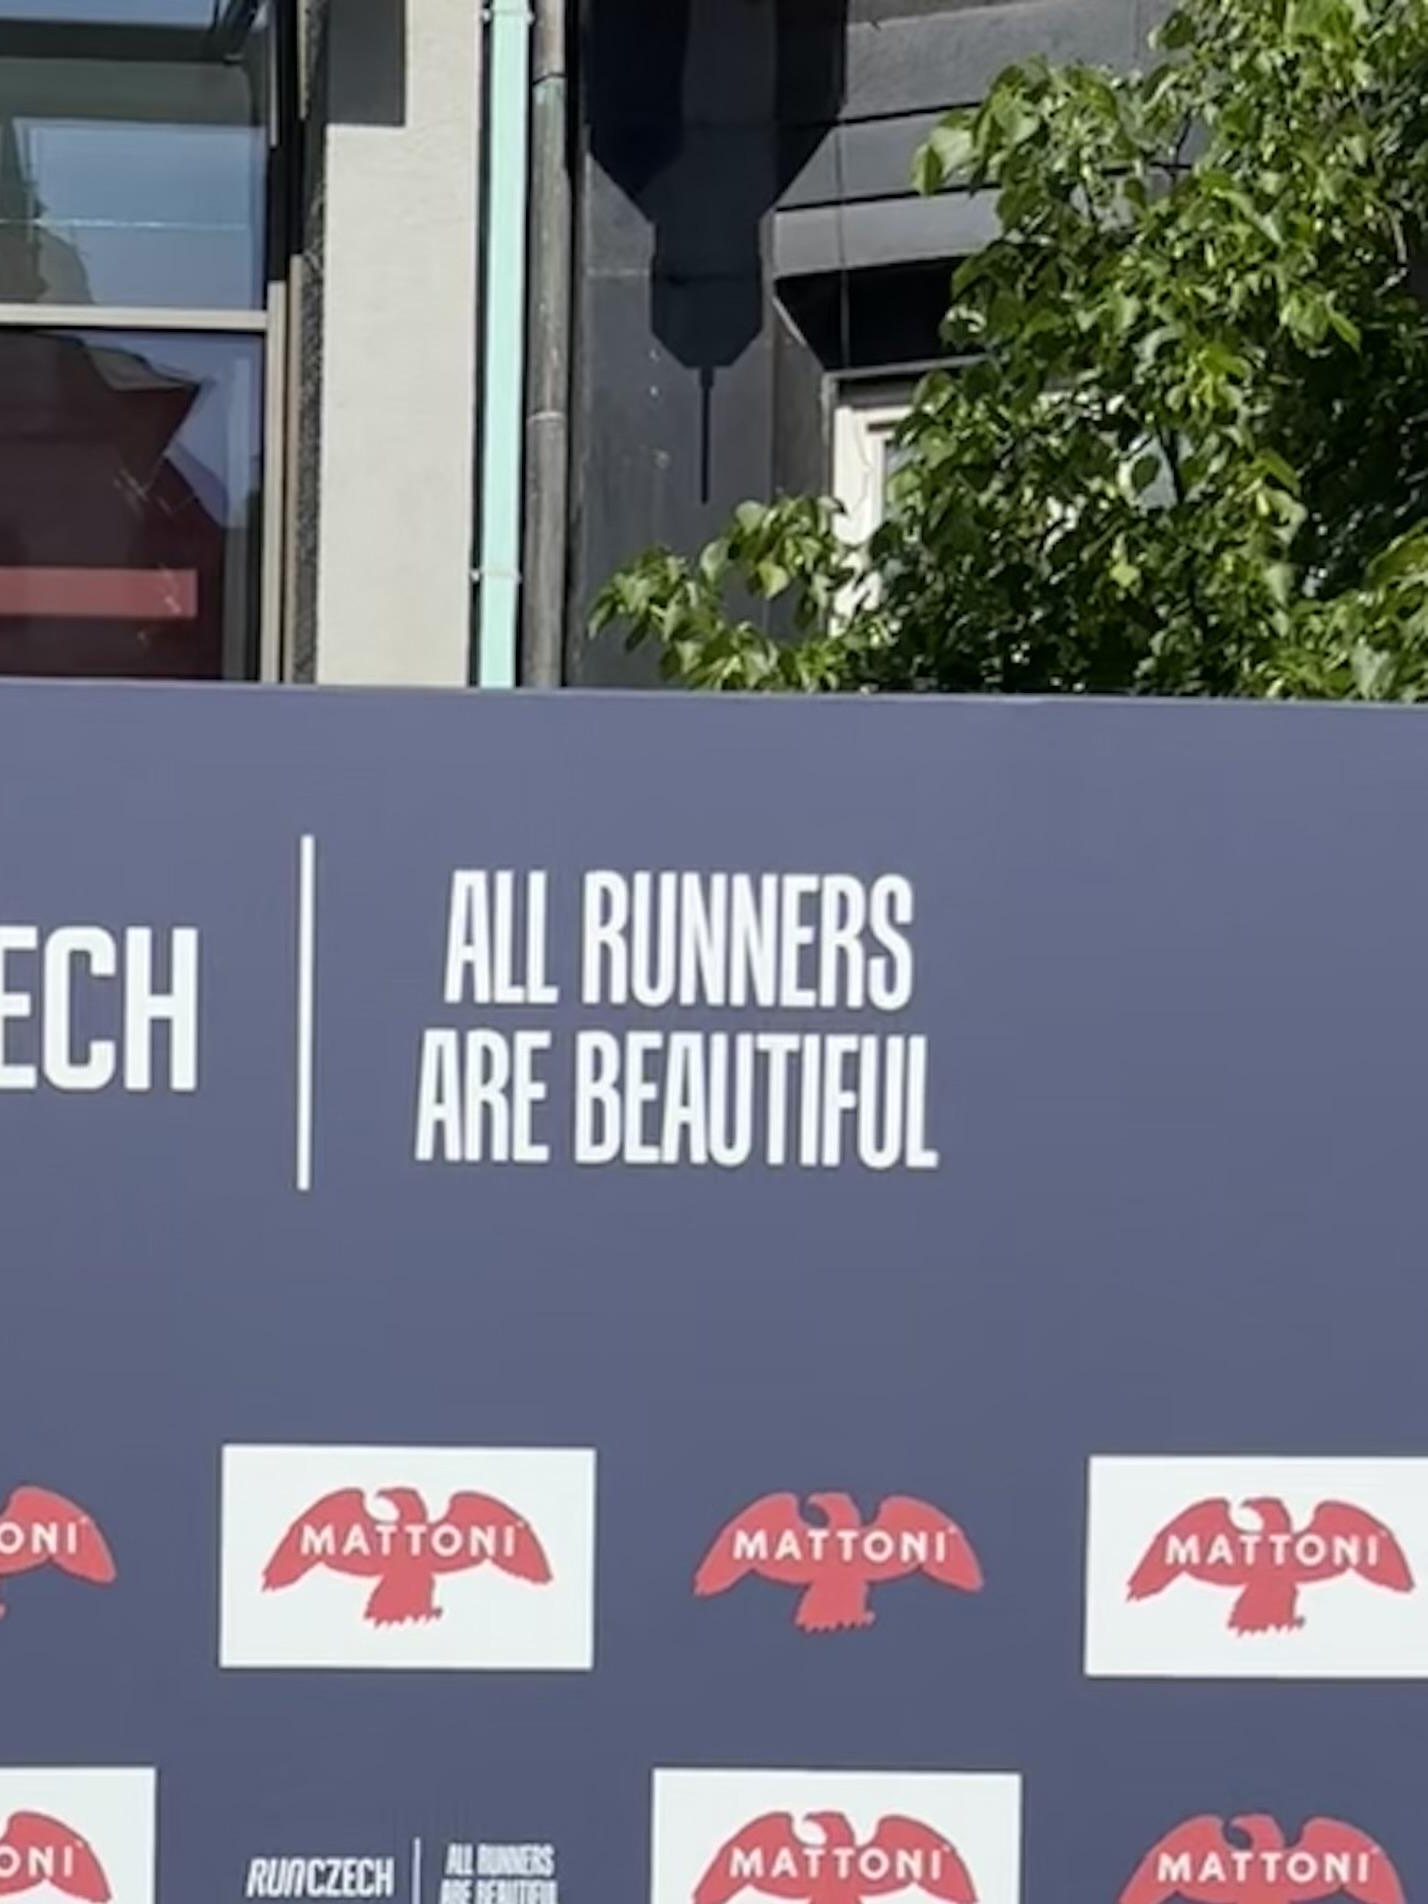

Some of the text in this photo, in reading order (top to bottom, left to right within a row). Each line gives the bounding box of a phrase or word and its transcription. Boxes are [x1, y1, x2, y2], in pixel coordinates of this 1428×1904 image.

[444, 870, 915, 1010] ALL RUNNERS
[415, 1028, 939, 1170] ARE BEAUTIFUL
[300, 1523, 515, 1558] MATTONI
[733, 1528, 946, 1563] MATTONI
[1165, 1533, 1378, 1567] MATTONI
[246, 1856, 395, 1899] RUNCZECH
[446, 1843, 555, 1877] ALL RUNNERS
[729, 1847, 941, 1881] MATTONI
[1157, 1850, 1369, 1883] MATTONI
